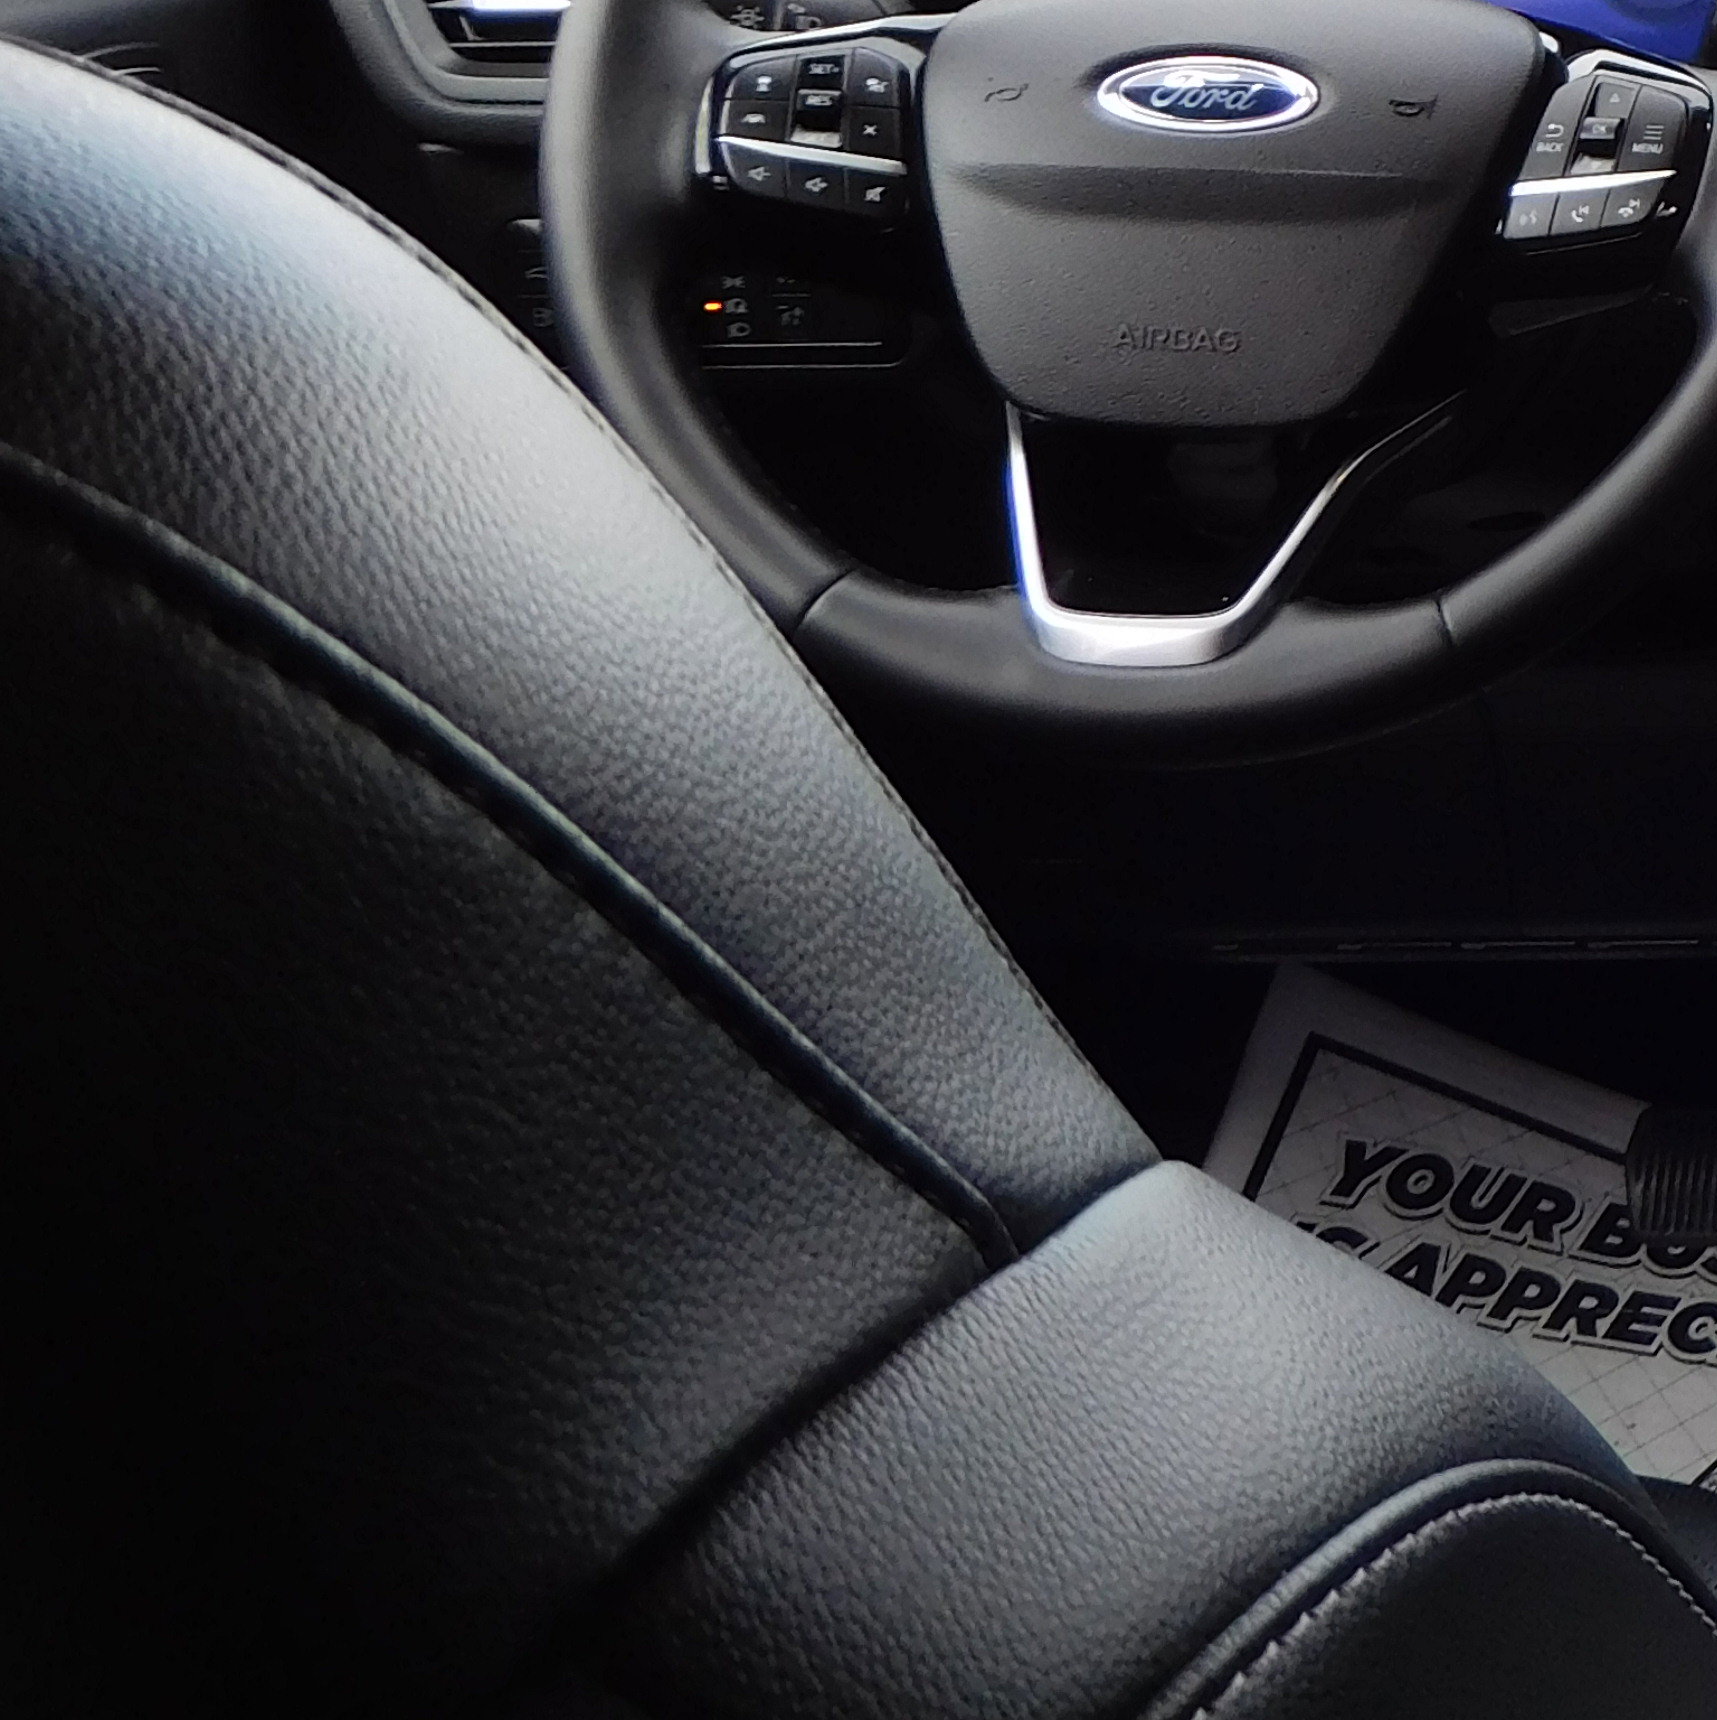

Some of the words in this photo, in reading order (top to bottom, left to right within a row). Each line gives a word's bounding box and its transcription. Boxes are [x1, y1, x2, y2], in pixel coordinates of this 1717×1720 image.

[1151, 69, 1264, 112] Ford
[1535, 141, 1565, 153] BACK
[1631, 142, 1664, 154] MENU
[1111, 324, 1243, 355] AIRBAG
[1323, 1138, 1588, 1247] YOUR
